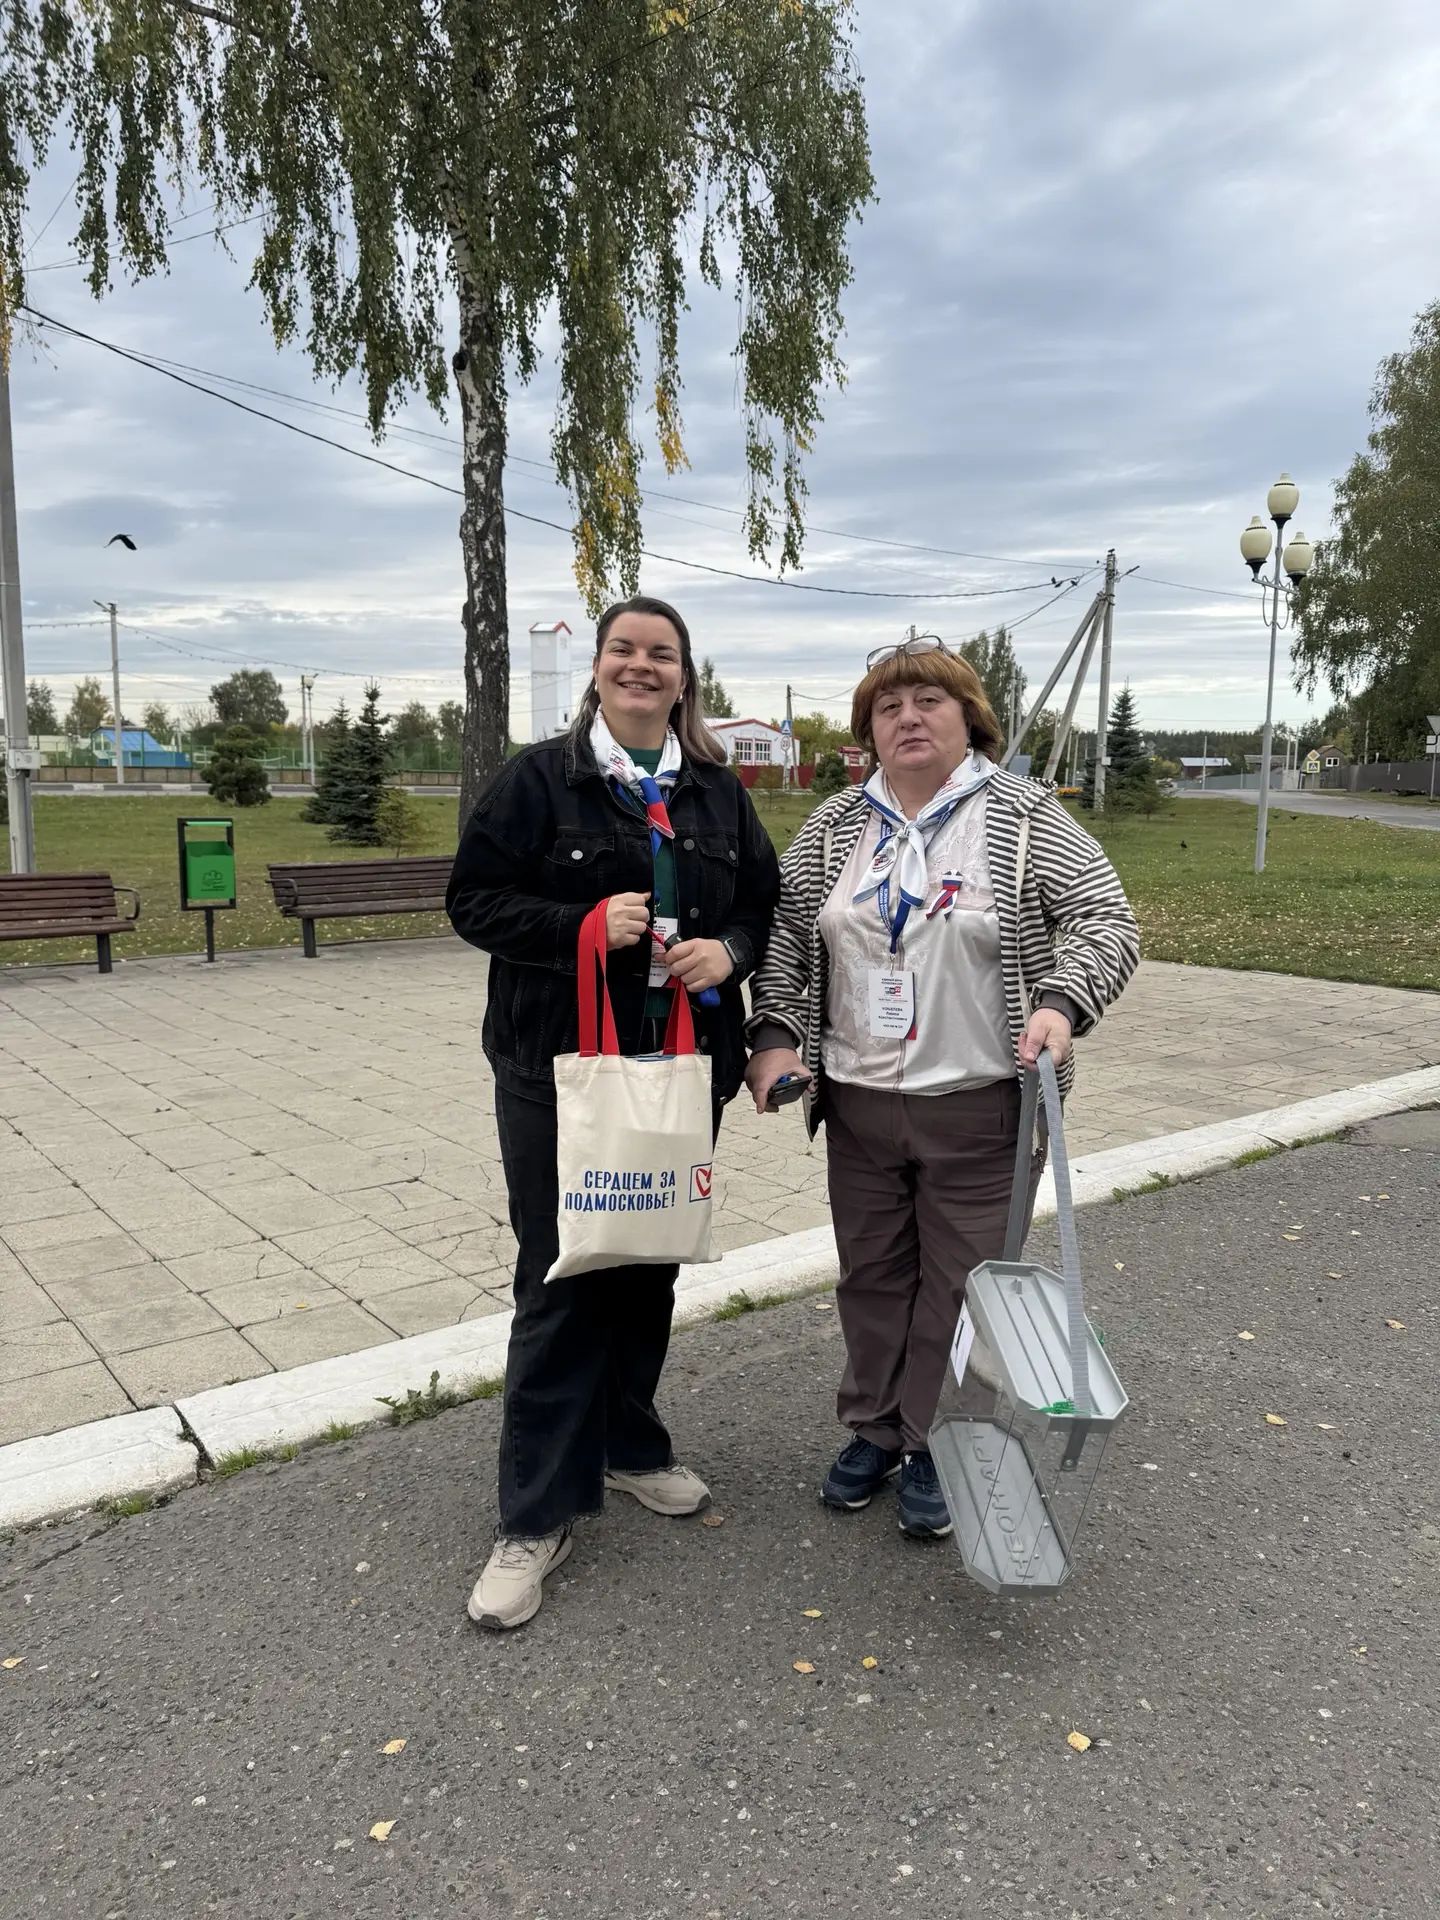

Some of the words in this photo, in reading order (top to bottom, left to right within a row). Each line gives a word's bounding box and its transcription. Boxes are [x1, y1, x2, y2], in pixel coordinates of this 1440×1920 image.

[585, 1170, 653, 1191] СЕРДЦЕМ
[660, 1170, 676, 1189] ЗА
[565, 1191, 676, 1212] ПОДМОСКОВЬЕ!
